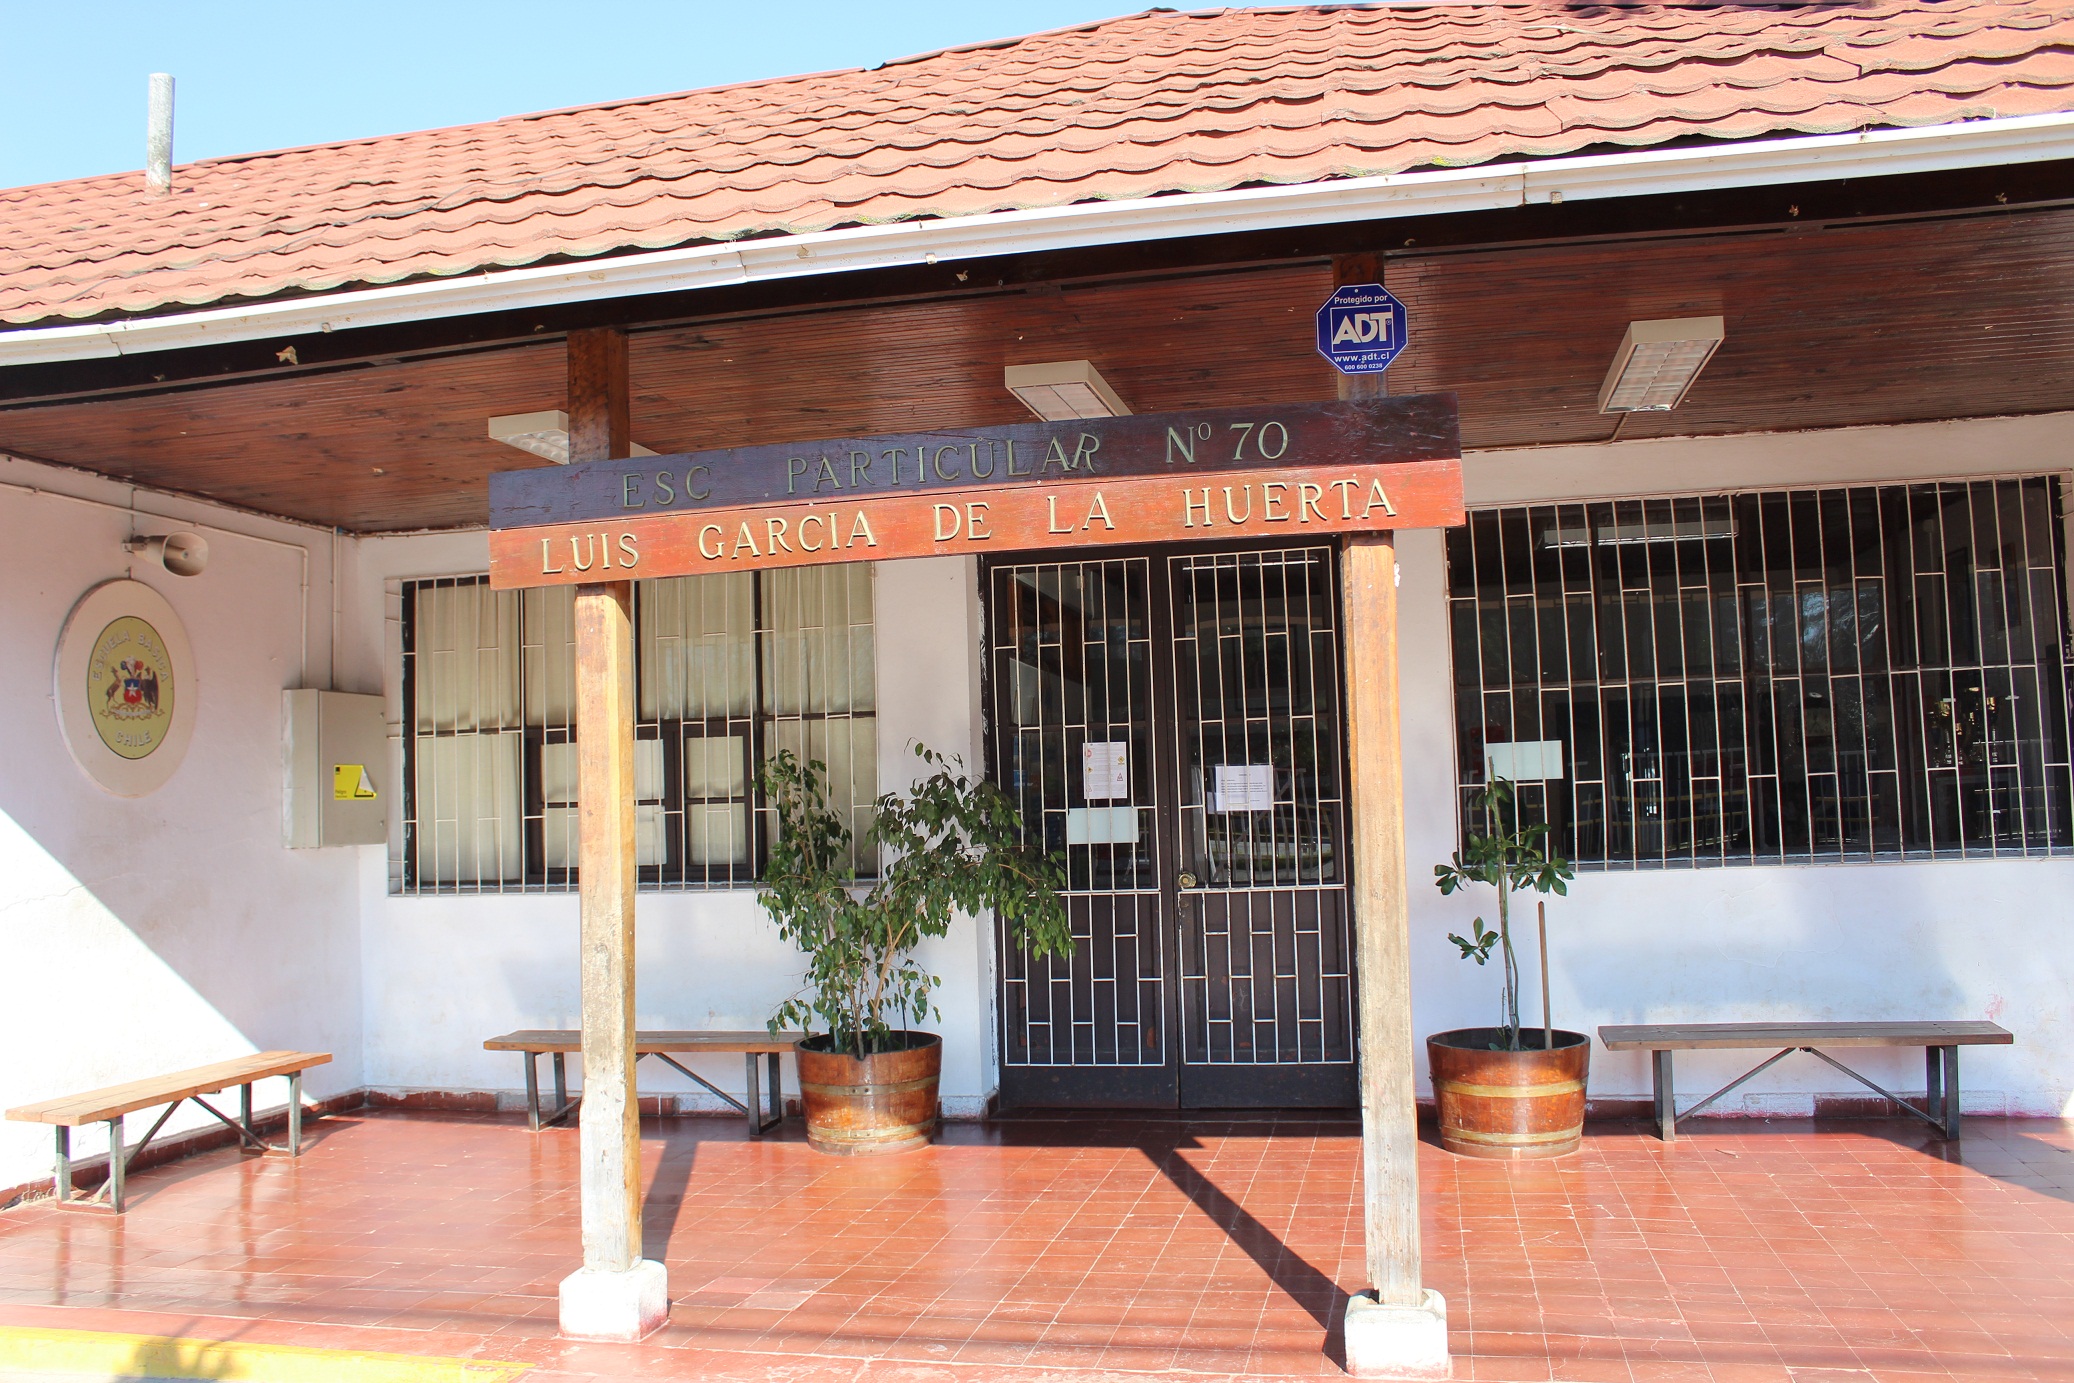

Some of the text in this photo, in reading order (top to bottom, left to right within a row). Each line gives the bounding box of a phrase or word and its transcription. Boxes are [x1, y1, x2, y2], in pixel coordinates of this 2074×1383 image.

[1334, 295, 1388, 305] Protegido por
[1333, 312, 1393, 344] ADT
[1334, 352, 1390, 362] www.adt.cl
[622, 465, 712, 509] ESC
[786, 431, 1101, 495] PARTICULAR
[1229, 420, 1289, 462] 70
[541, 478, 1398, 575] LUIS GARCIA DE LA HUERTA
[92, 630, 169, 683] ESCUELA BASICA
[114, 730, 152, 748] CHILE
